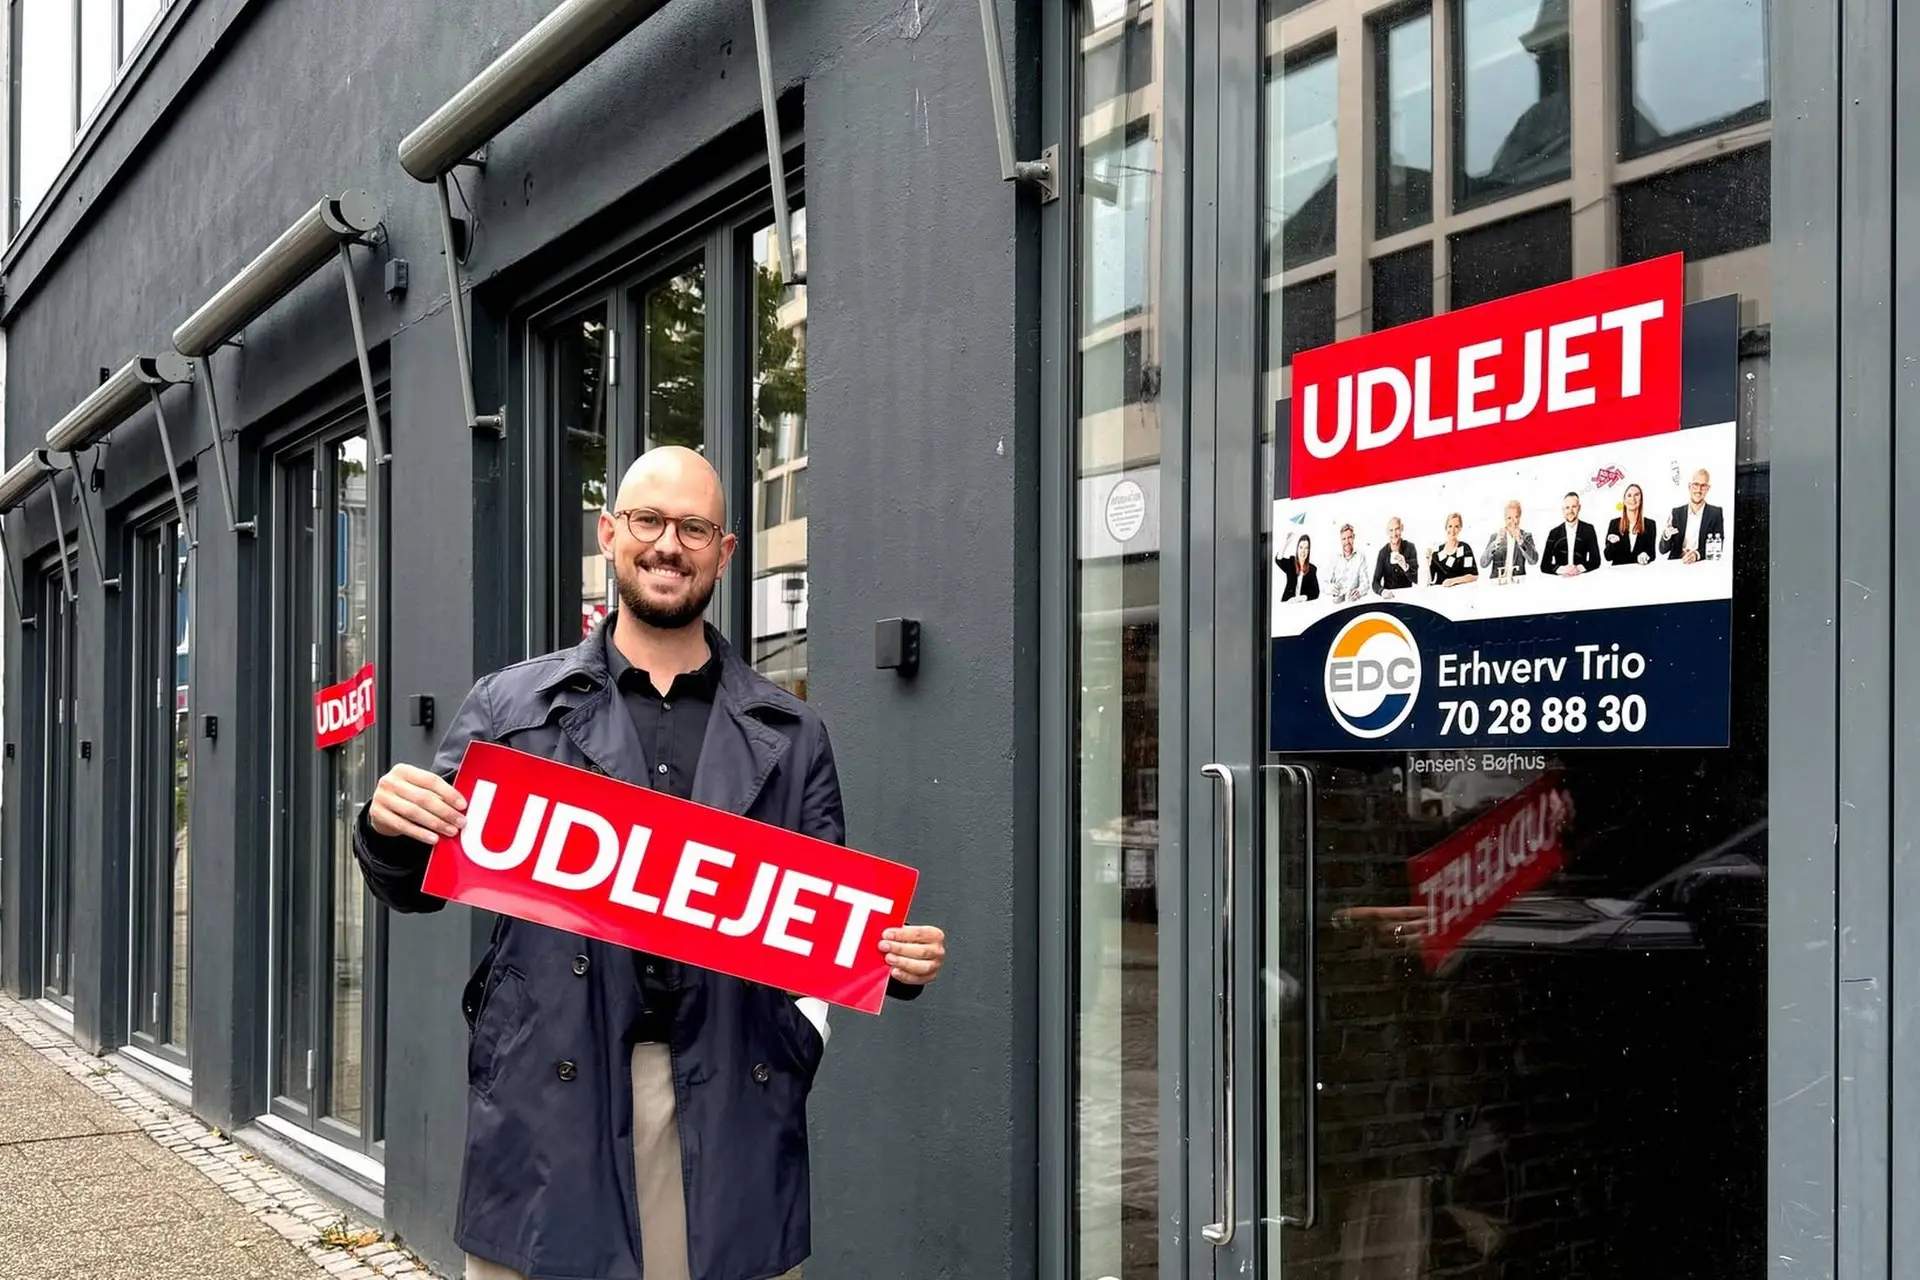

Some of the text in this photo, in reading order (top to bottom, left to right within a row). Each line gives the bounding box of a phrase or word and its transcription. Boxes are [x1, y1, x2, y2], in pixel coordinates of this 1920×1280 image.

[1303, 300, 1665, 459] UDLEJET
[1329, 657, 1415, 693] EDC
[1438, 643, 1646, 688] Erhverv Trio
[1438, 694, 1647, 735] 70 28 88 30
[1408, 753, 1546, 774] Jensen's Bøfhus
[460, 780, 894, 969] UDLEJET
